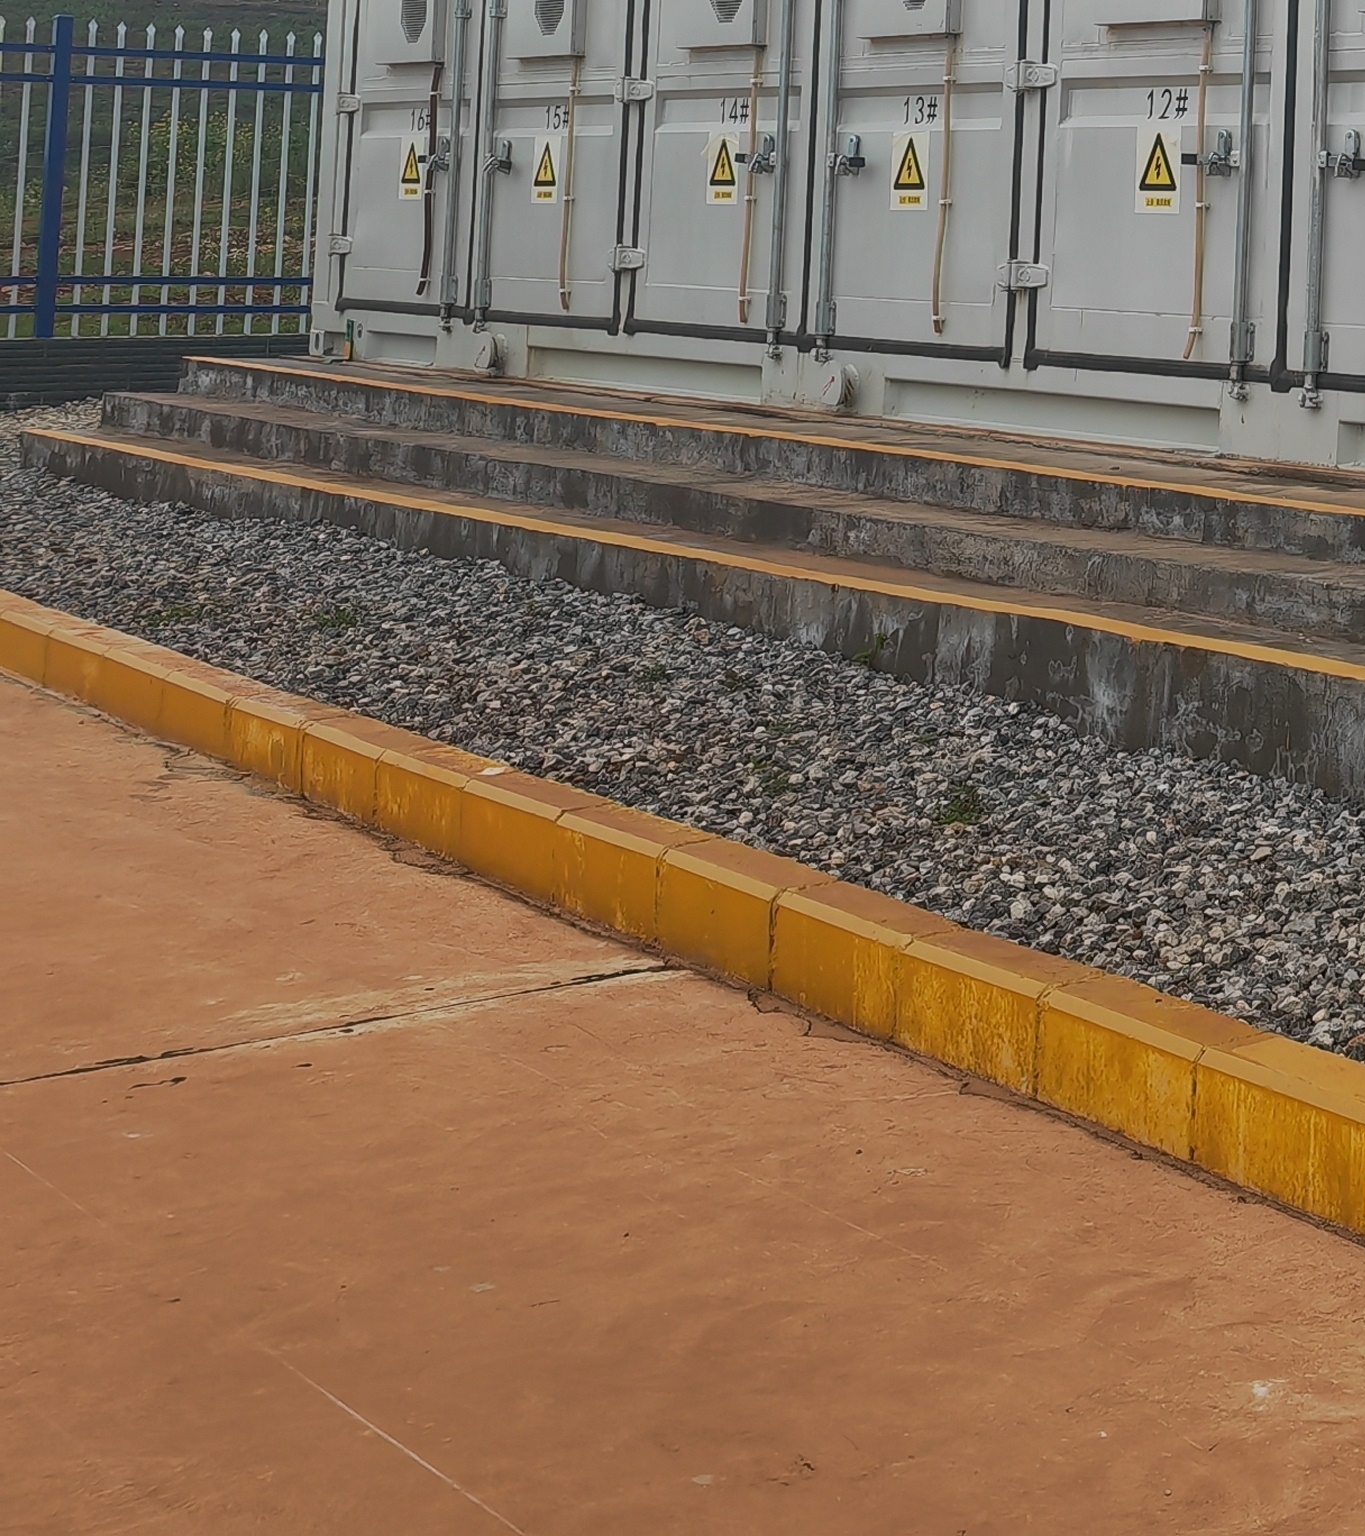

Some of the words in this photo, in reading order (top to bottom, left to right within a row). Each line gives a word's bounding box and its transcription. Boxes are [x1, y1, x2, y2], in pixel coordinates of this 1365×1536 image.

[720, 96, 749, 124] 14#
[904, 96, 938, 124] 13#
[1147, 88, 1188, 119] 12#
